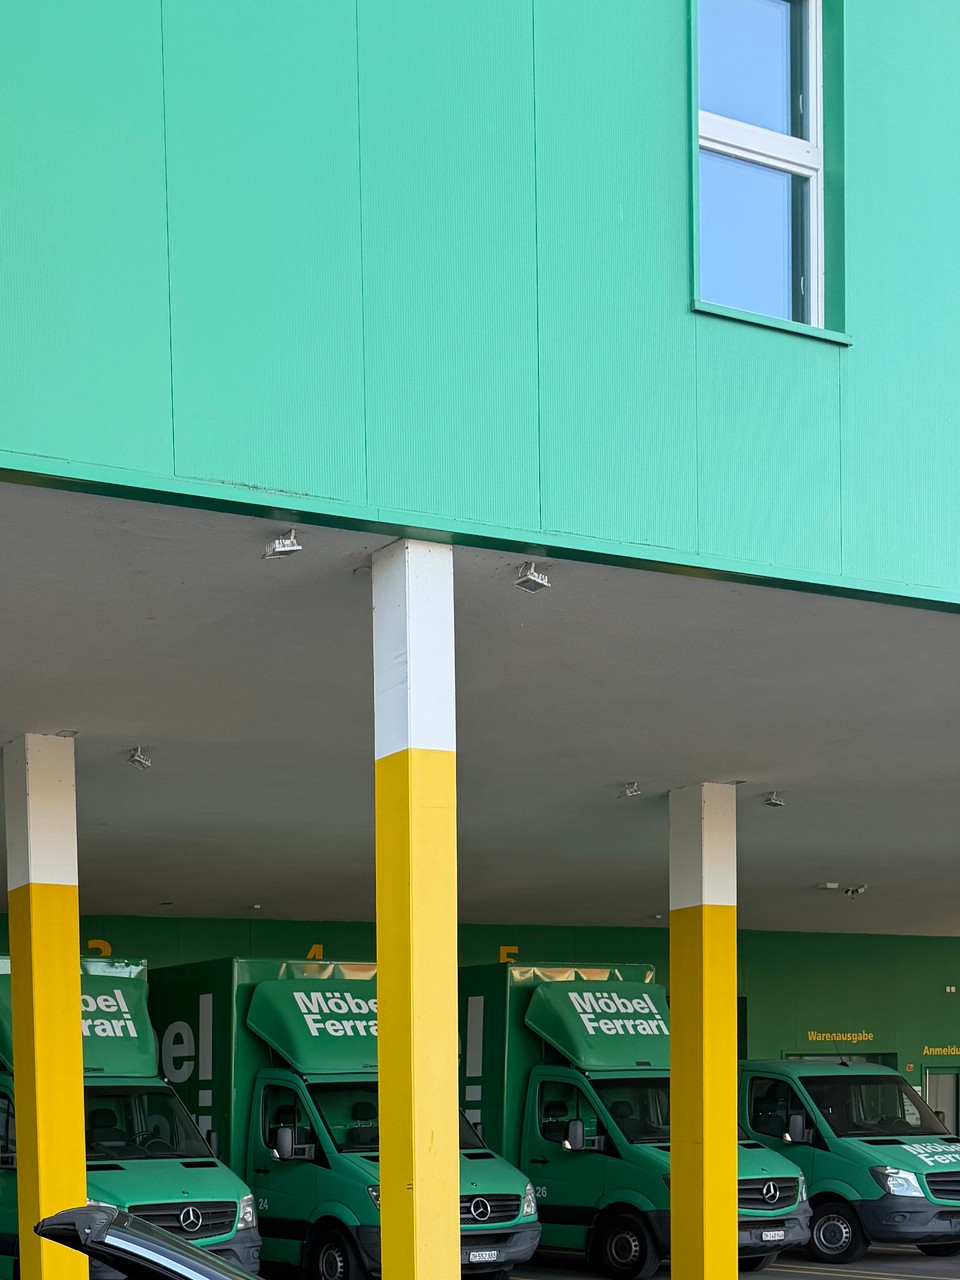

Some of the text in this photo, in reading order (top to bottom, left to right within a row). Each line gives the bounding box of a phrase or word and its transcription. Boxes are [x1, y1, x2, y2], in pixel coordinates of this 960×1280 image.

[80, 989, 129, 1013] bel
[293, 991, 378, 1014] Möbe
[568, 992, 658, 1014] Möbel
[81, 1013, 138, 1038] rari
[303, 1014, 378, 1036] Ferra
[580, 1013, 670, 1036] Ferrari
[808, 1030, 874, 1043] Warenausgabe
[535, 1186, 548, 1198] 26
[258, 1198, 269, 1210] 24
